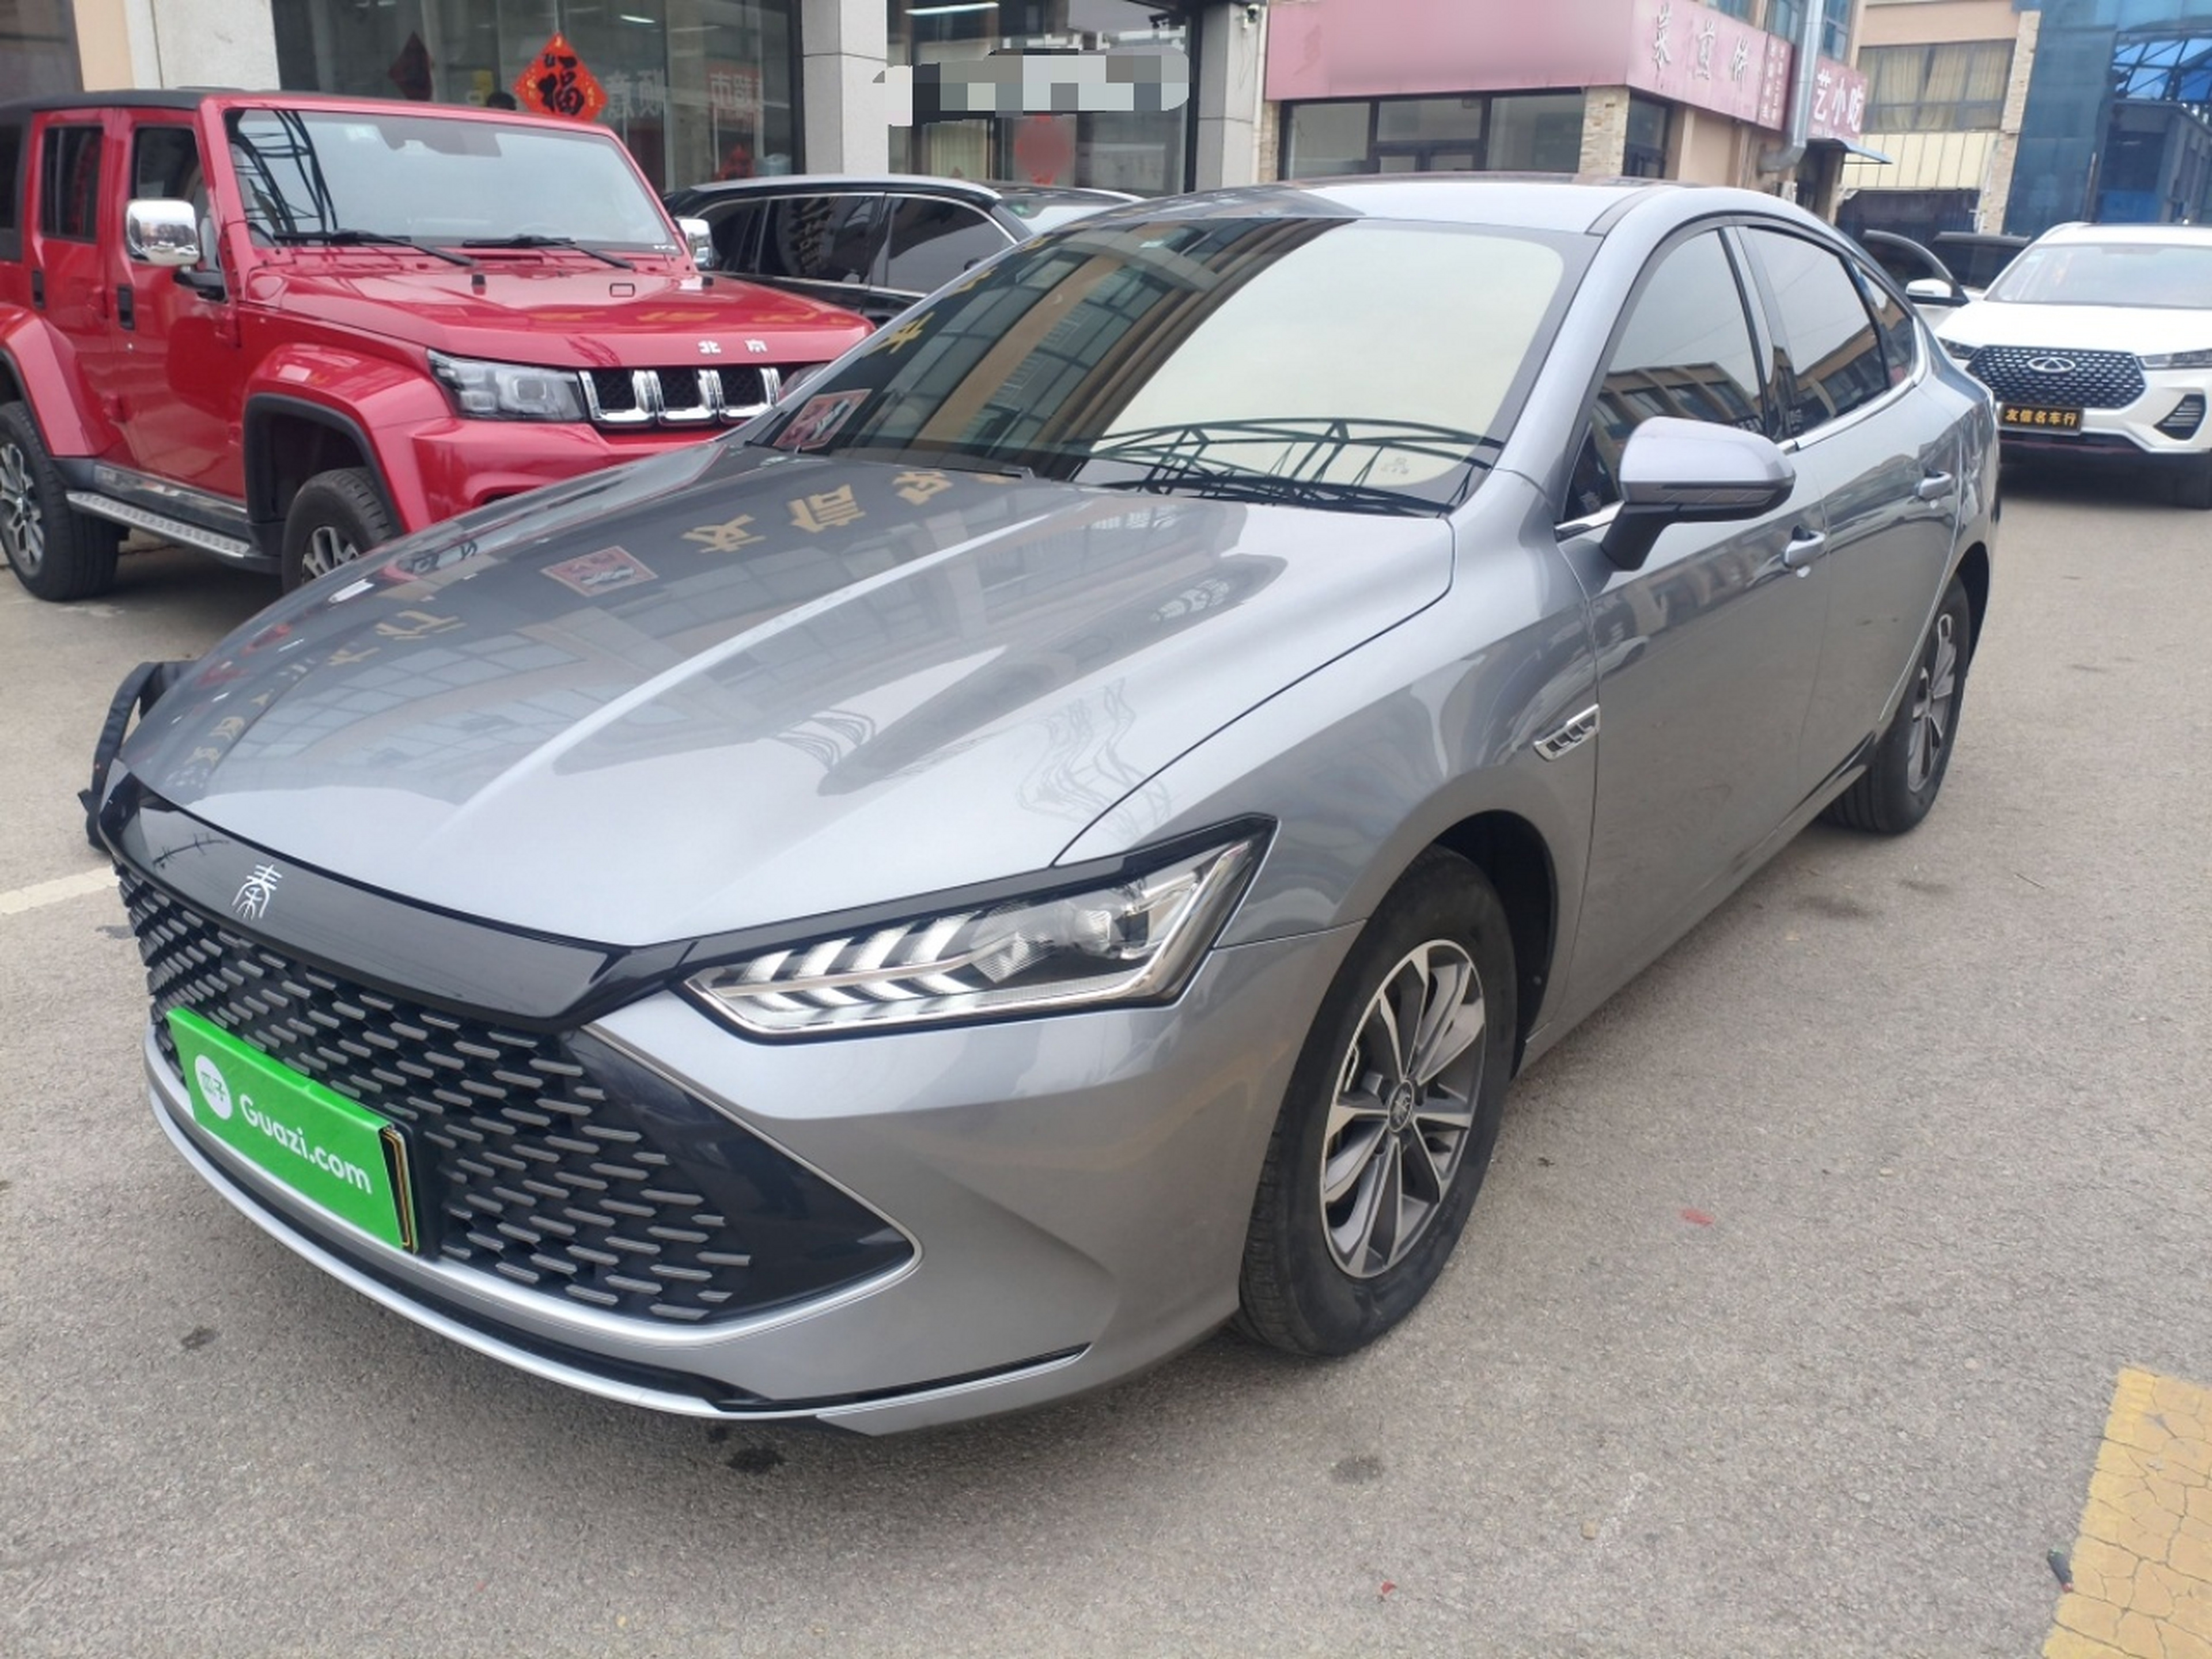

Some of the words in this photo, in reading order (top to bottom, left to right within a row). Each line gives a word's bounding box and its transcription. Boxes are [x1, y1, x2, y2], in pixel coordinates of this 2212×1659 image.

[537, 53, 585, 116] 福
[698, 339, 768, 354] 北京
[2005, 408, 2077, 427] 友信名车行
[239, 1093, 373, 1195] Guazi.com
